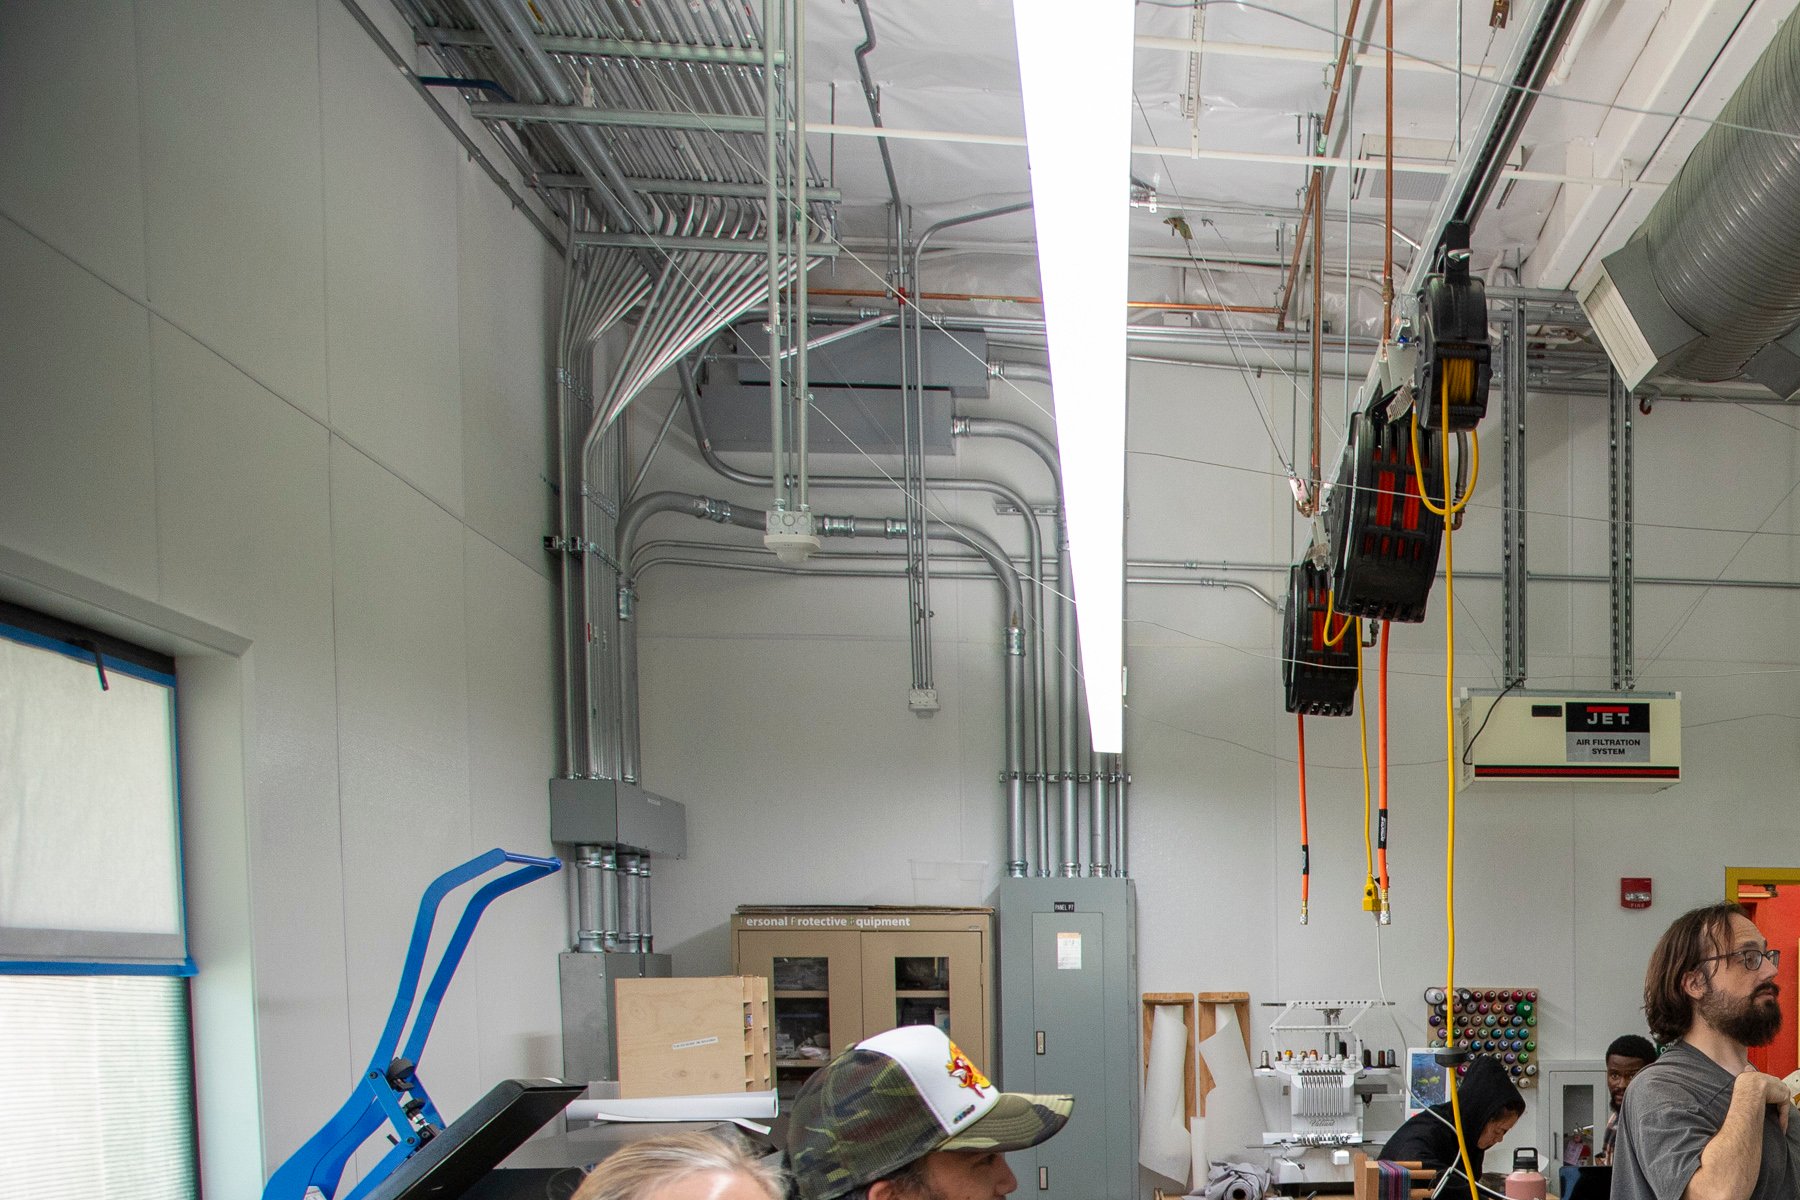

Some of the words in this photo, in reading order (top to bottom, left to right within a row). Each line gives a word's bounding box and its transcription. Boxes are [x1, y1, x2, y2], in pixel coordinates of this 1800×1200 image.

[1587, 712, 1629, 725] JET
[1576, 738, 1591, 746] AIR
[1592, 738, 1641, 746] FILTRATION
[1591, 747, 1626, 755] SYSTEM
[1054, 903, 1067, 911] PANEL
[850, 916, 911, 929] quipment
